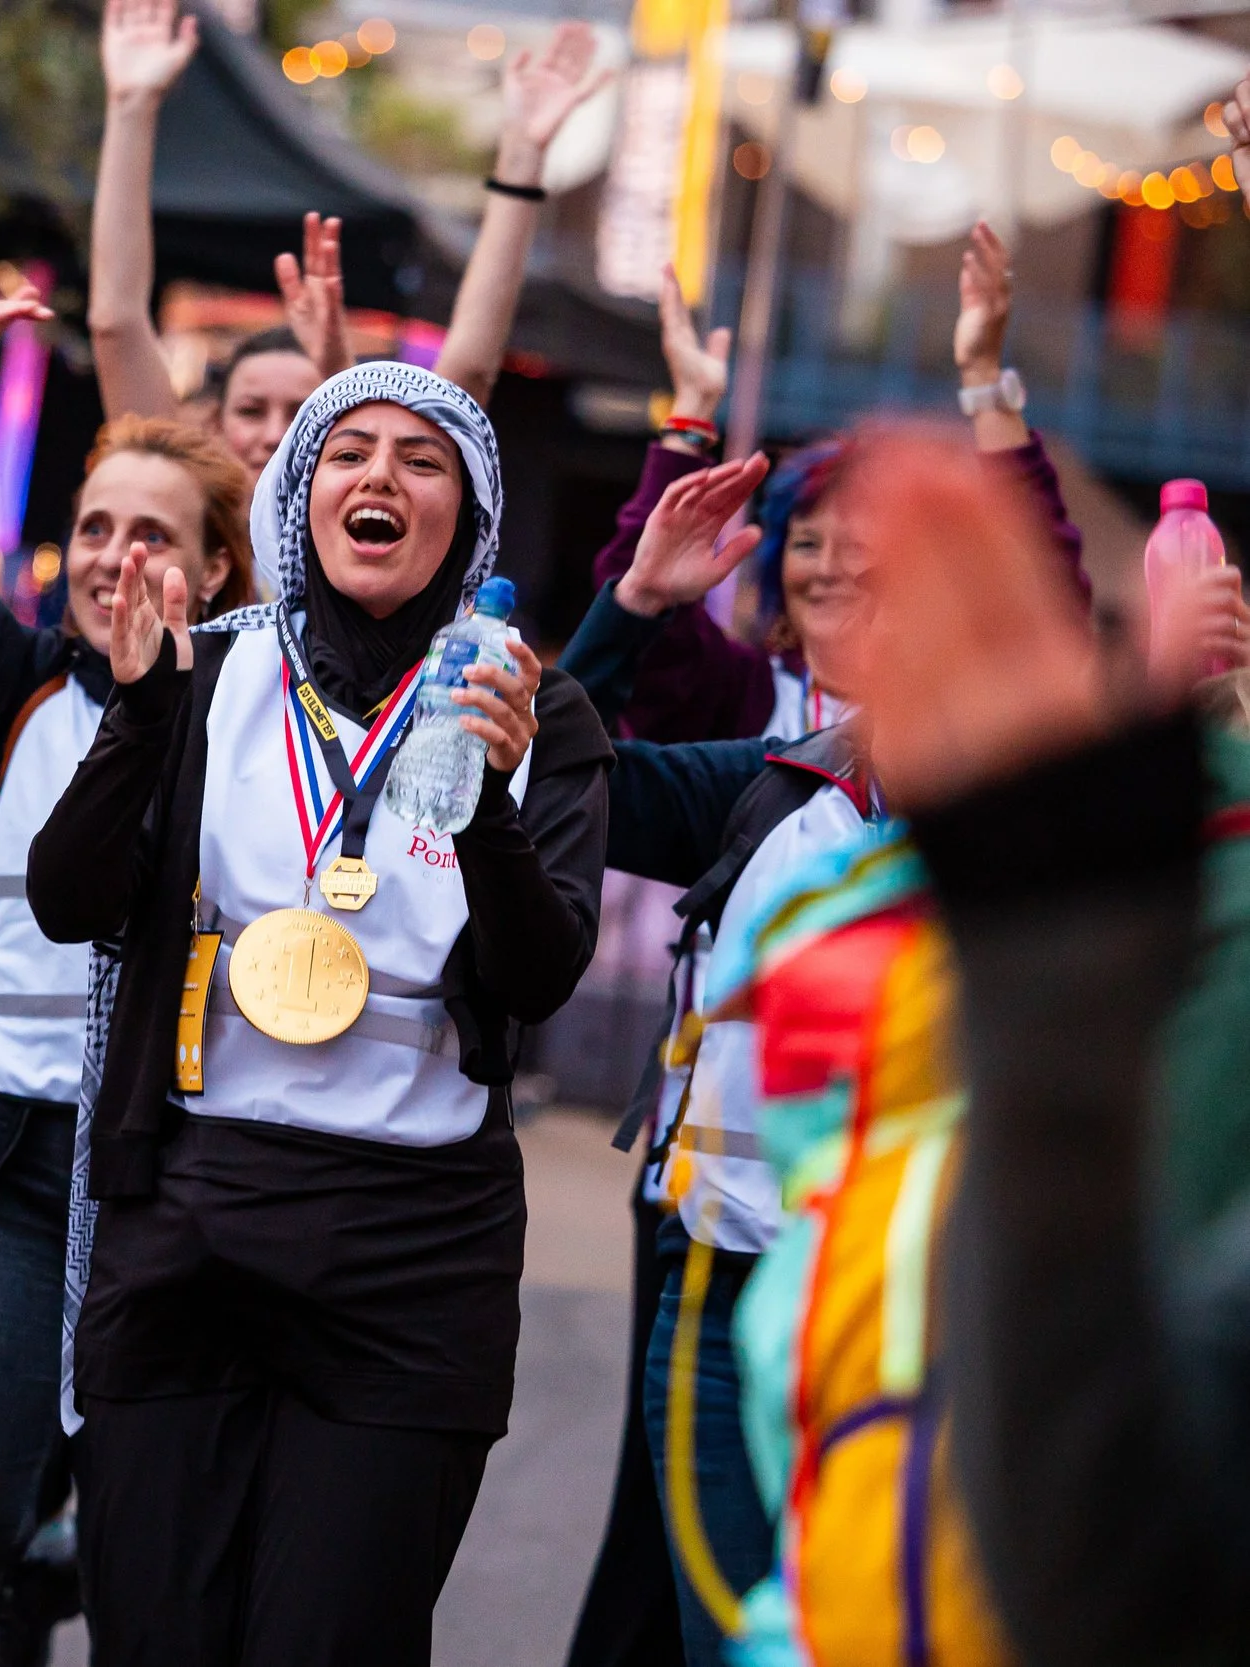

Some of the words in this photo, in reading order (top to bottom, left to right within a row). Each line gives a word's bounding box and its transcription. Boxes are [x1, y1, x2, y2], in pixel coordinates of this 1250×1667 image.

[287, 640, 307, 681] VLUCHTELING
[300, 686, 311, 698] 20
[306, 695, 336, 737] KILOMETER
